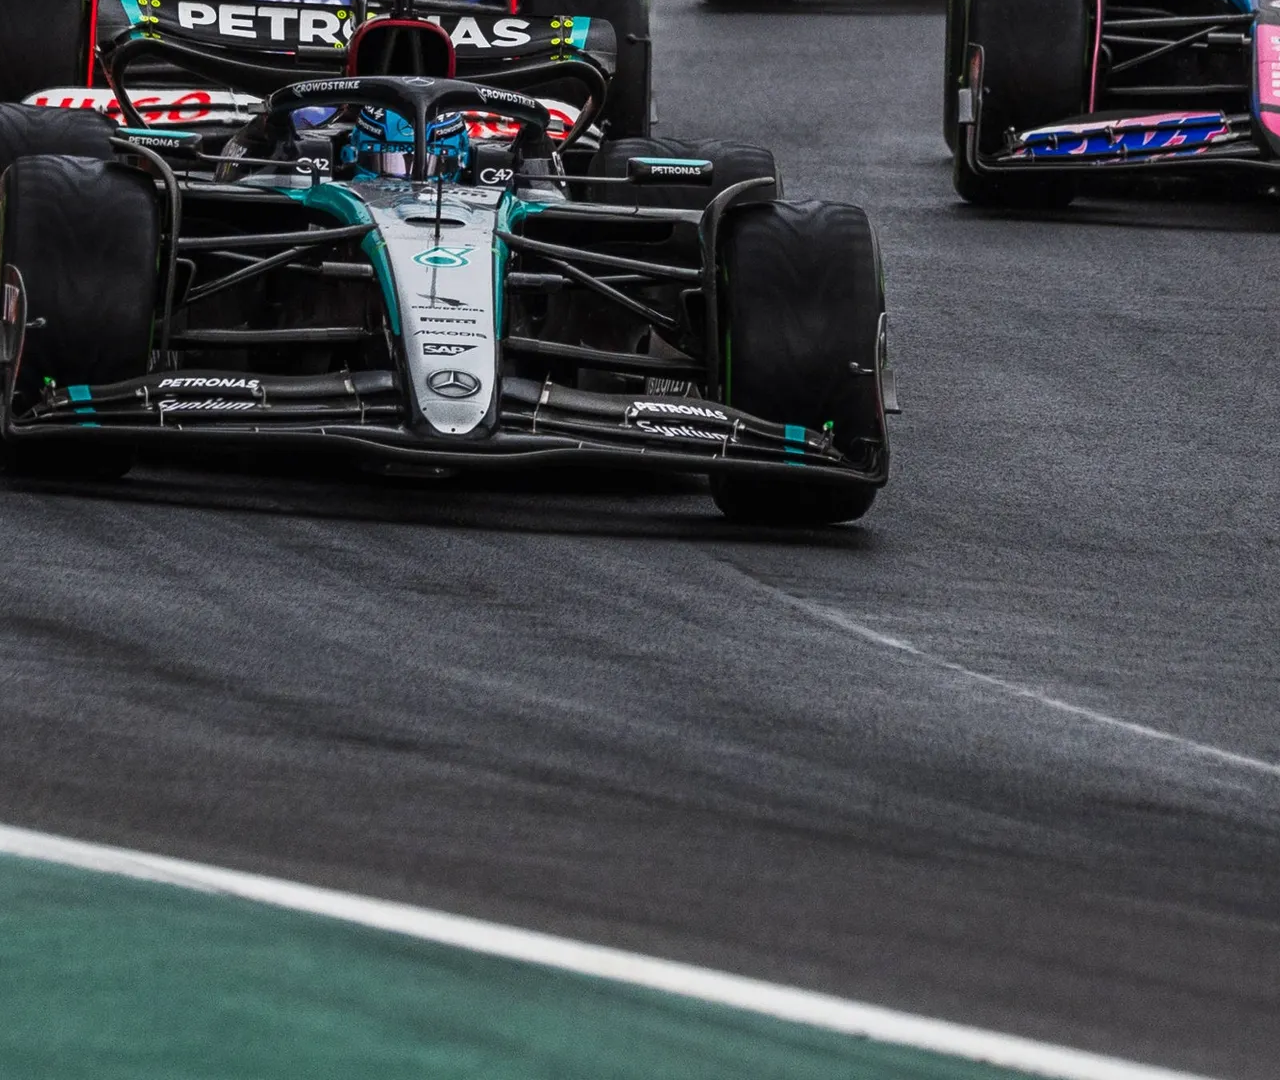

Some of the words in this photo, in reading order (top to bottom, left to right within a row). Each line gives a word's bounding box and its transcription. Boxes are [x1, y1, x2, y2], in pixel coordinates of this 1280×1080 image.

[178, 1, 532, 50] PETRAS
[295, 80, 361, 94] CROWDSTRIKE
[129, 135, 180, 149] PETRONAS
[650, 165, 701, 176] PETRONAS
[413, 329, 488, 340] AKKODIS
[158, 378, 260, 390] PETRONAS
[633, 401, 728, 420] PETRONAS
[636, 420, 729, 440] Syntium
